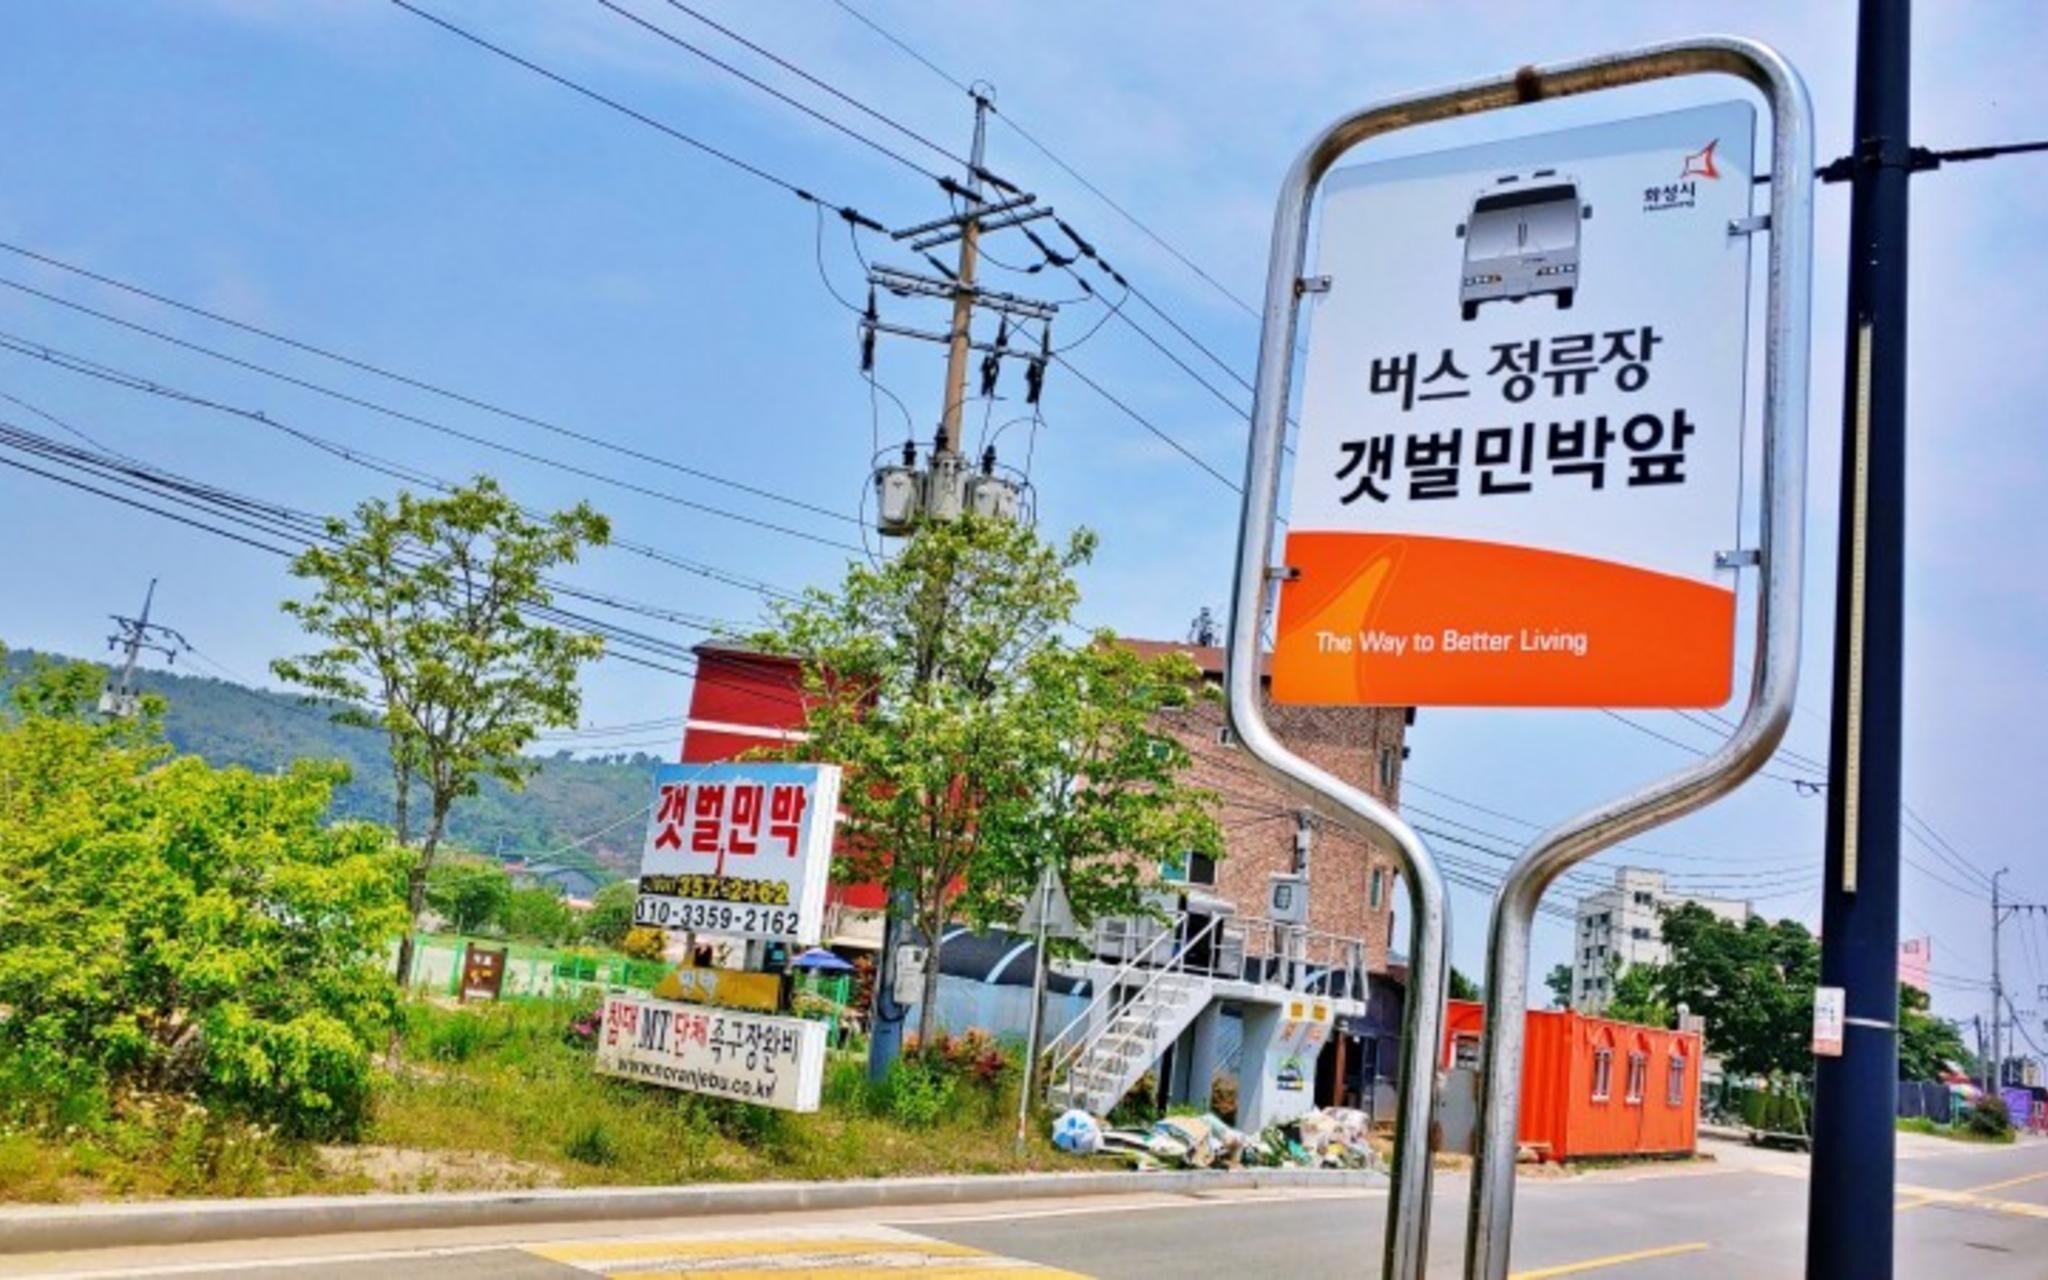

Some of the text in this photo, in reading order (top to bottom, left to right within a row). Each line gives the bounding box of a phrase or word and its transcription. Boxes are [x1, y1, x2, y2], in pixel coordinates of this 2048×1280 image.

[1644, 181, 1696, 203] 화성시
[1368, 325, 1663, 411] 버스 정류장
[1335, 408, 1696, 505] 갯벌민박앞
[1316, 628, 1588, 656] The Way to Better Living
[654, 783, 807, 858] 갯벌민박
[635, 899, 799, 936] 010-3359-2162
